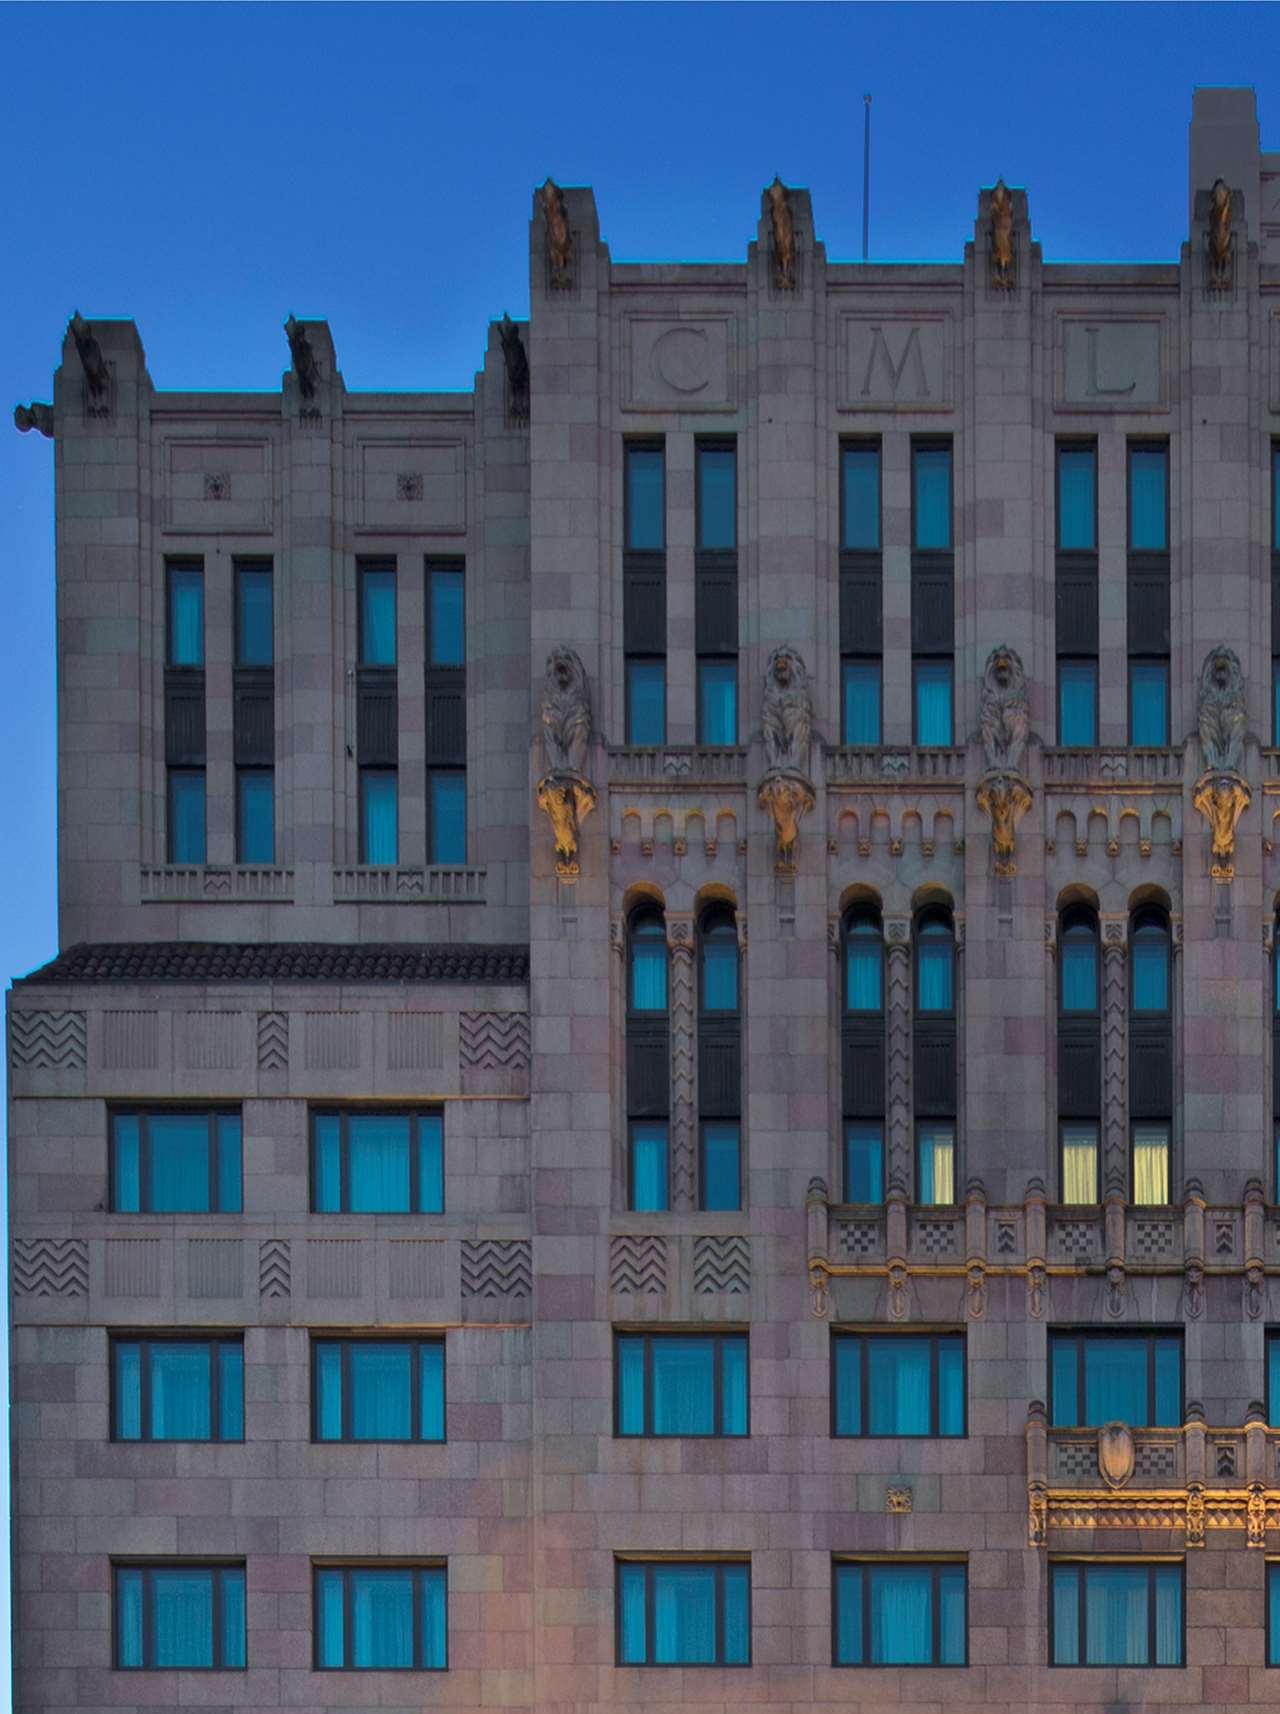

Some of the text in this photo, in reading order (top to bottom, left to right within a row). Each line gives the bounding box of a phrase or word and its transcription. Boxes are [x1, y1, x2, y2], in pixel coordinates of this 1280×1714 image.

[651, 327, 710, 393] C
[860, 327, 931, 396] M
[1085, 328, 1136, 396] L
